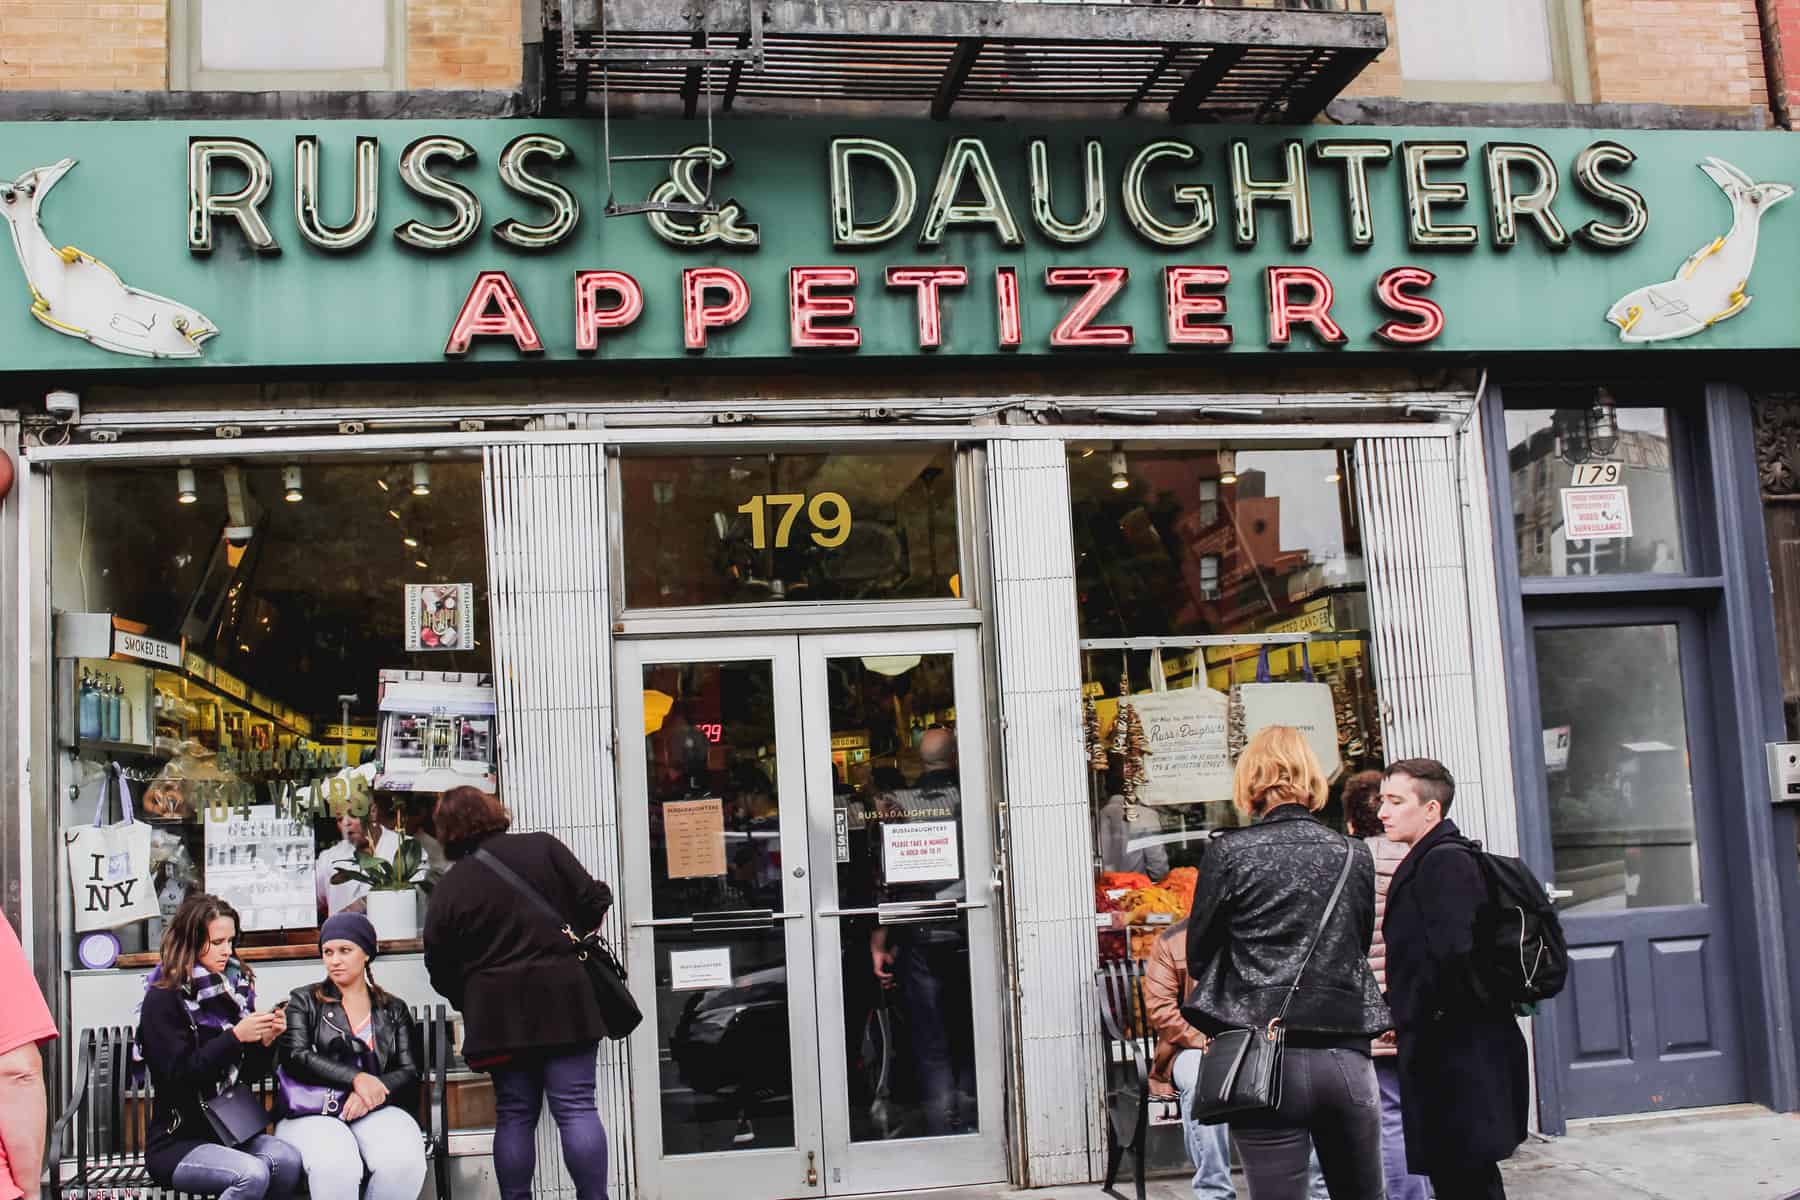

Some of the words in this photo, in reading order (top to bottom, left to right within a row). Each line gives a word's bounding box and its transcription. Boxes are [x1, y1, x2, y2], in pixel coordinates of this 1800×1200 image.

[187, 134, 580, 255] RUSS
[645, 146, 760, 250] &
[829, 136, 1650, 250] DAUGHTERS
[444, 264, 1444, 356] APPETIZERS
[1578, 465, 1617, 484] 179
[737, 492, 852, 550] 179
[124, 638, 154, 656] SMOKED
[156, 646, 169, 660] EEL
[268, 775, 370, 819] YEARS
[836, 813, 847, 858] PUSH
[89, 853, 105, 881] I
[84, 878, 138, 911] NY
